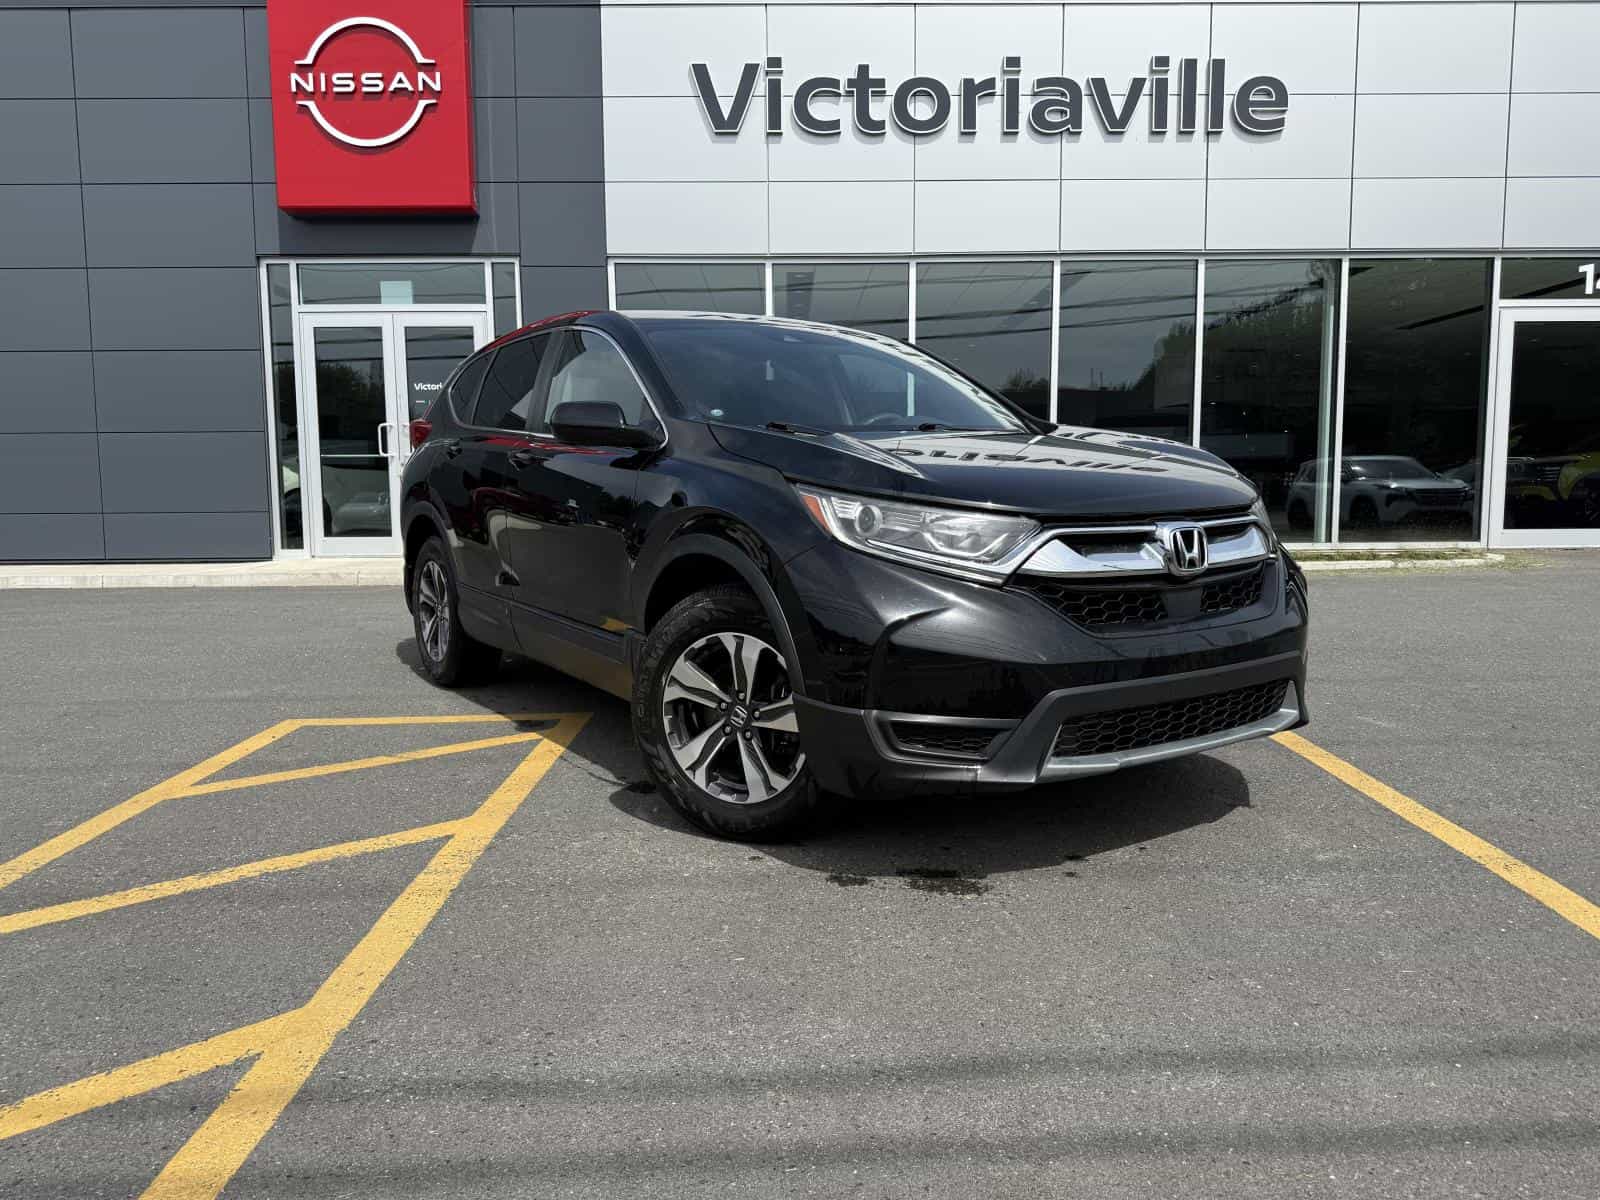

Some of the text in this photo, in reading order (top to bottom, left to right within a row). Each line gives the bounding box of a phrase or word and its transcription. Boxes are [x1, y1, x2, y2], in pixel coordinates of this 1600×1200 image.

[290, 72, 442, 93] NISSAN
[691, 56, 1289, 136] Victoriaville
[1579, 263, 1600, 295] 1
